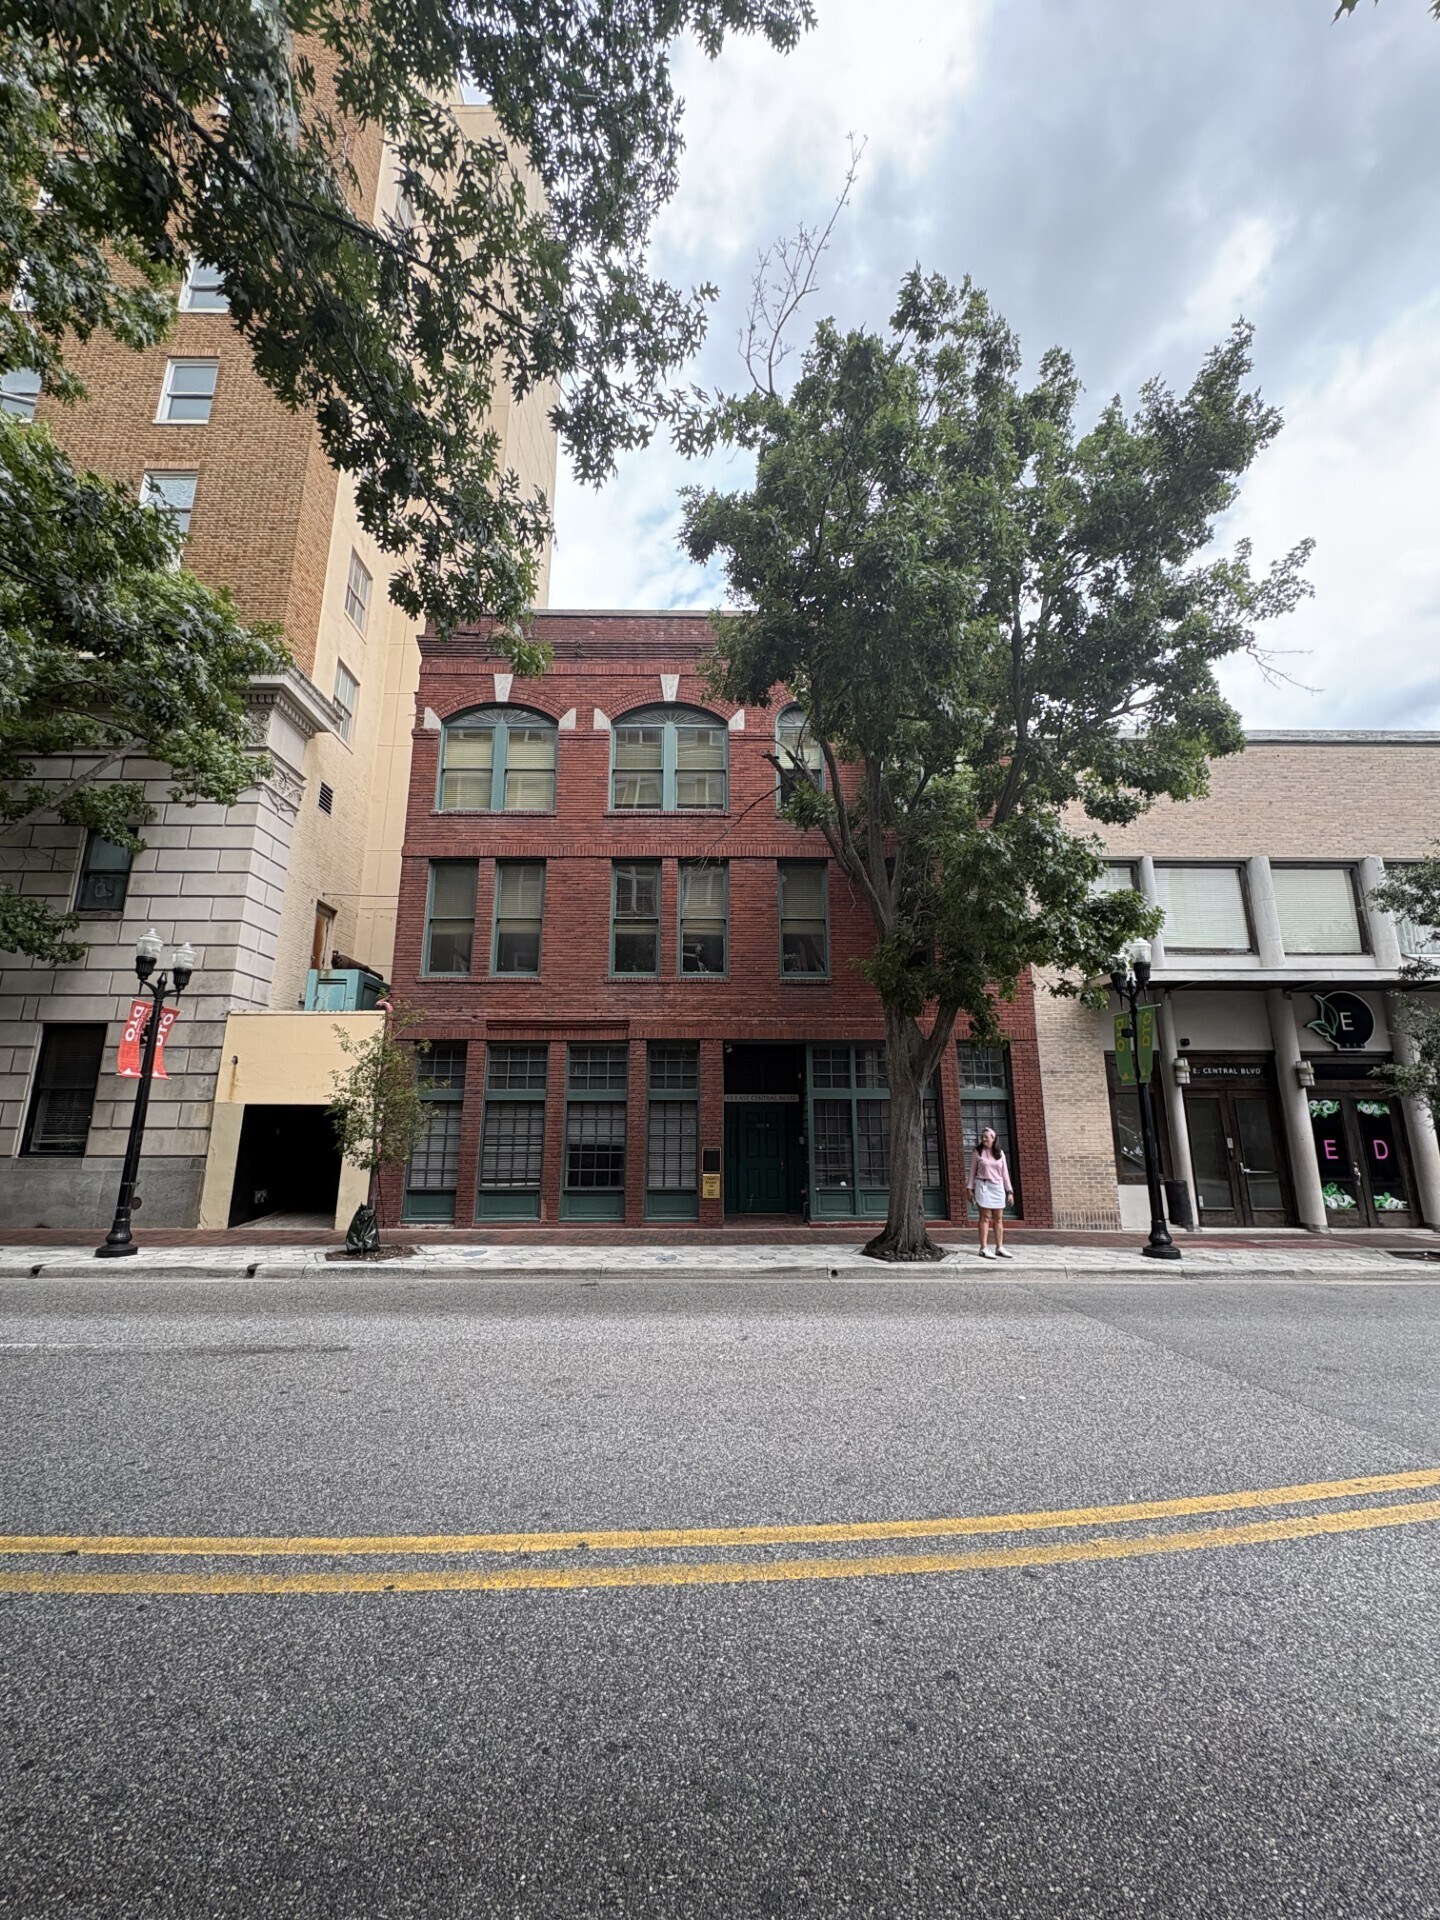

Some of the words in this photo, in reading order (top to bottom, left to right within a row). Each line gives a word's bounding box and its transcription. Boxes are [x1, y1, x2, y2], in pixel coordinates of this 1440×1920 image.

[125, 1006, 145, 1042] DTO
[157, 1013, 174, 1047] DTO
[1142, 1012, 1152, 1047] DTO
[1340, 1012, 1354, 1030] E
[1203, 1067, 1238, 1075] CENTRAL
[1240, 1067, 1261, 1075] BLVD
[1323, 1139, 1339, 1159] E
[1373, 1139, 1389, 1160] D
